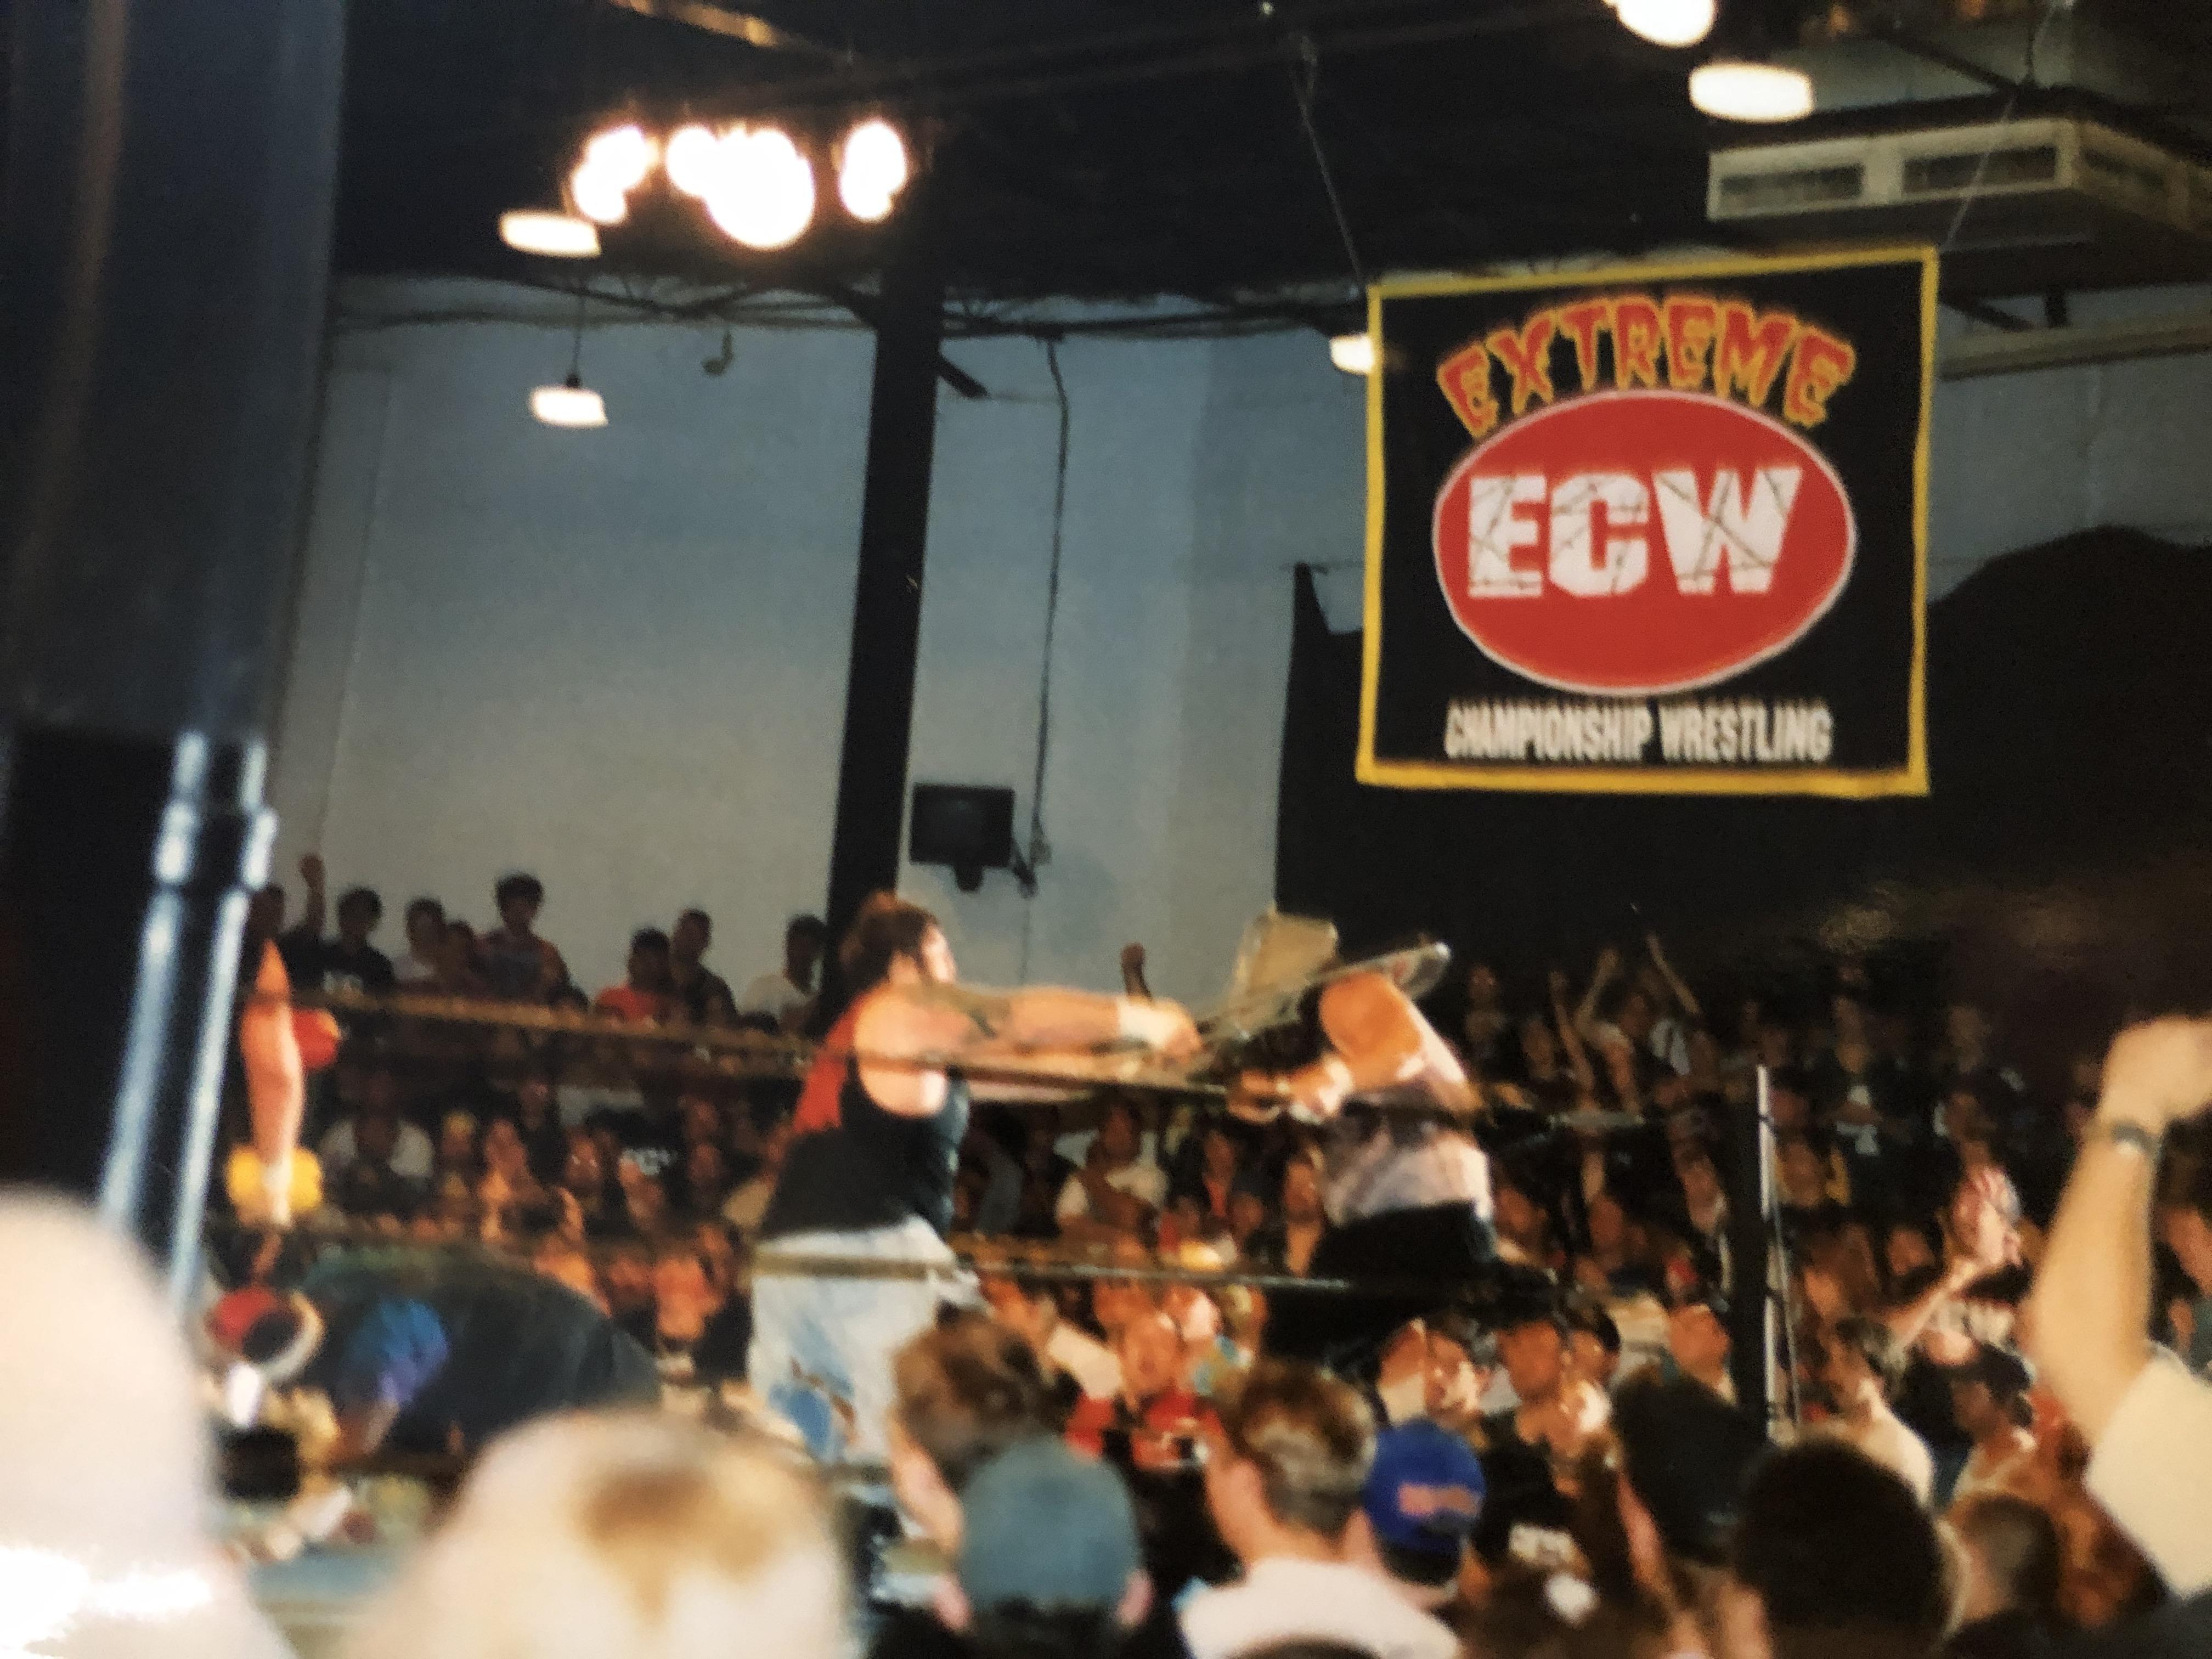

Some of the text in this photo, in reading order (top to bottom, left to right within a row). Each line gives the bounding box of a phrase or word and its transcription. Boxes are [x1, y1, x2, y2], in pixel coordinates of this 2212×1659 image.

[1436, 295, 1857, 439] EXTREME
[1467, 466, 1803, 599] ECW
[1443, 698, 1833, 763] CHAMPIONSHIP WRESTLING
